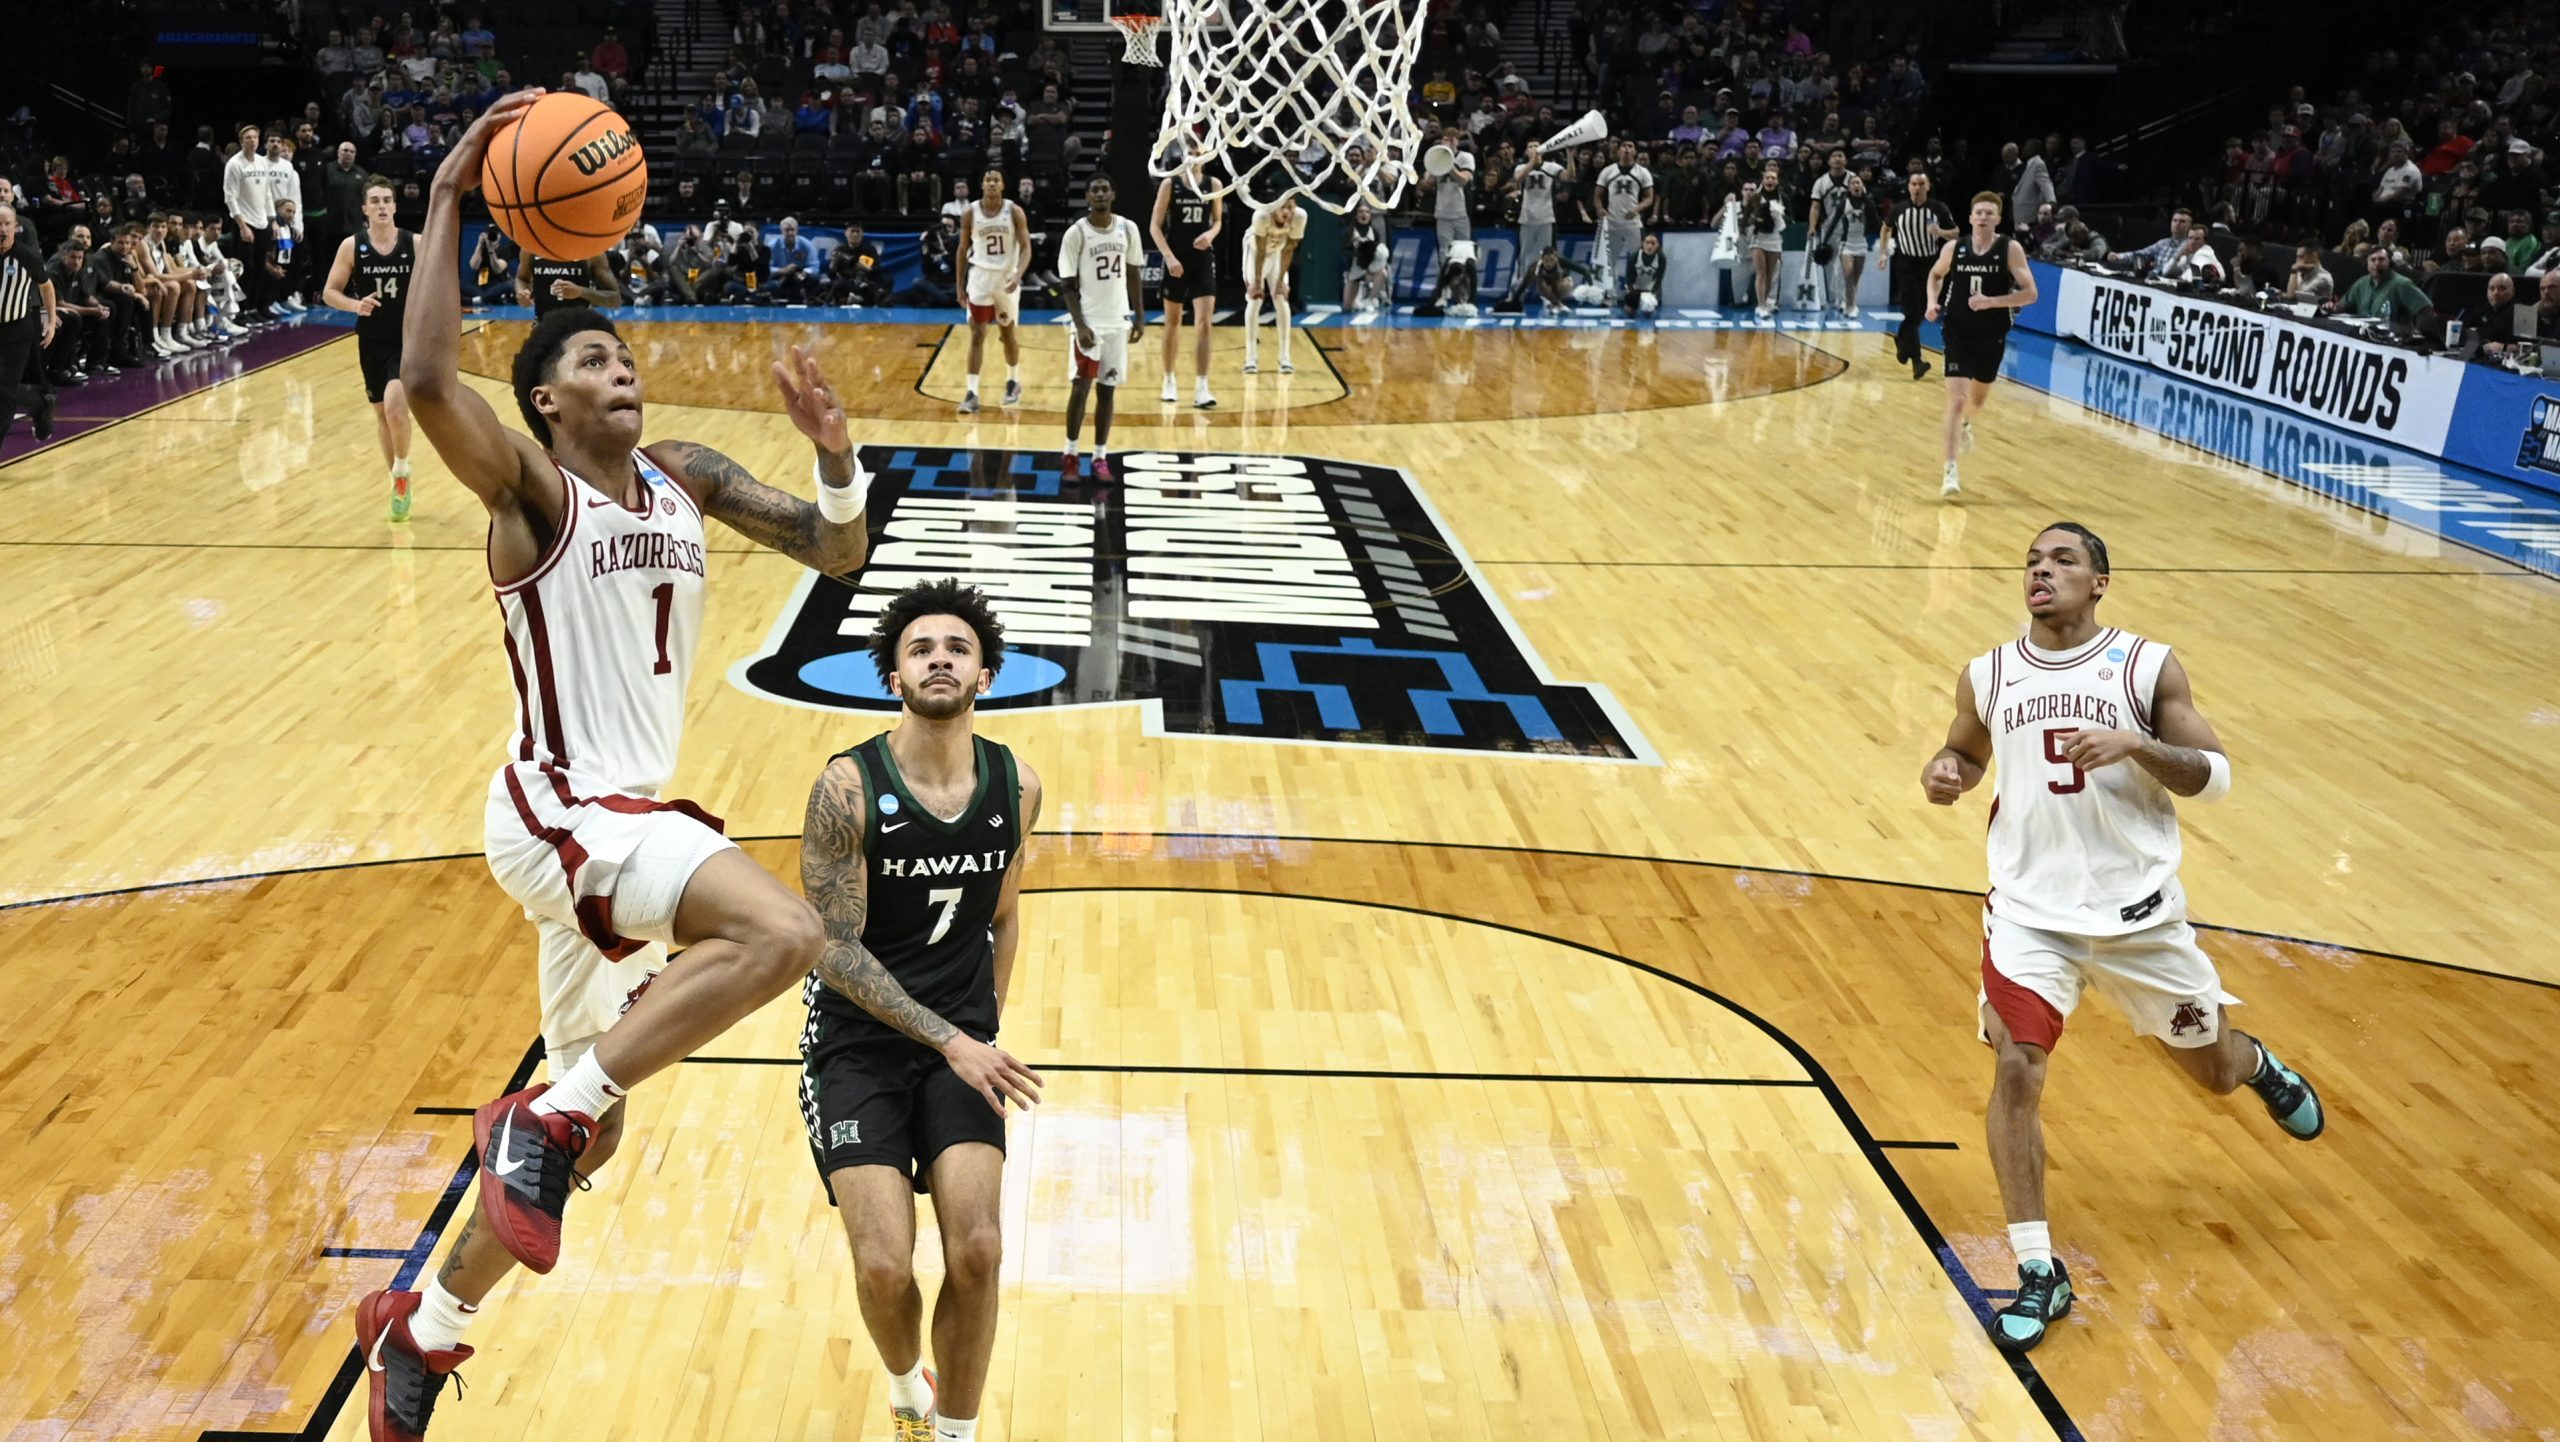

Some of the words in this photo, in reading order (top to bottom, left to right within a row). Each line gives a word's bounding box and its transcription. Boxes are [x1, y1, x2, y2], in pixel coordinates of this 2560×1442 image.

[1182, 206, 1203, 223] 20
[986, 235, 1005, 256] 21
[1095, 254, 1121, 280] 24
[375, 277, 398, 298] 14
[2090, 285, 2151, 356] FIRST
[2150, 316, 2167, 345] AND
[2167, 305, 2265, 390] SECOND
[2268, 329, 2408, 431] ROUNDS
[1122, 452, 1380, 629] MADNESS
[838, 497, 1096, 647] MARCH
[651, 582, 674, 676] 1
[2003, 693, 2118, 734] RAZORBACKS
[2043, 727, 2086, 795] 5
[926, 887, 964, 946] 7
